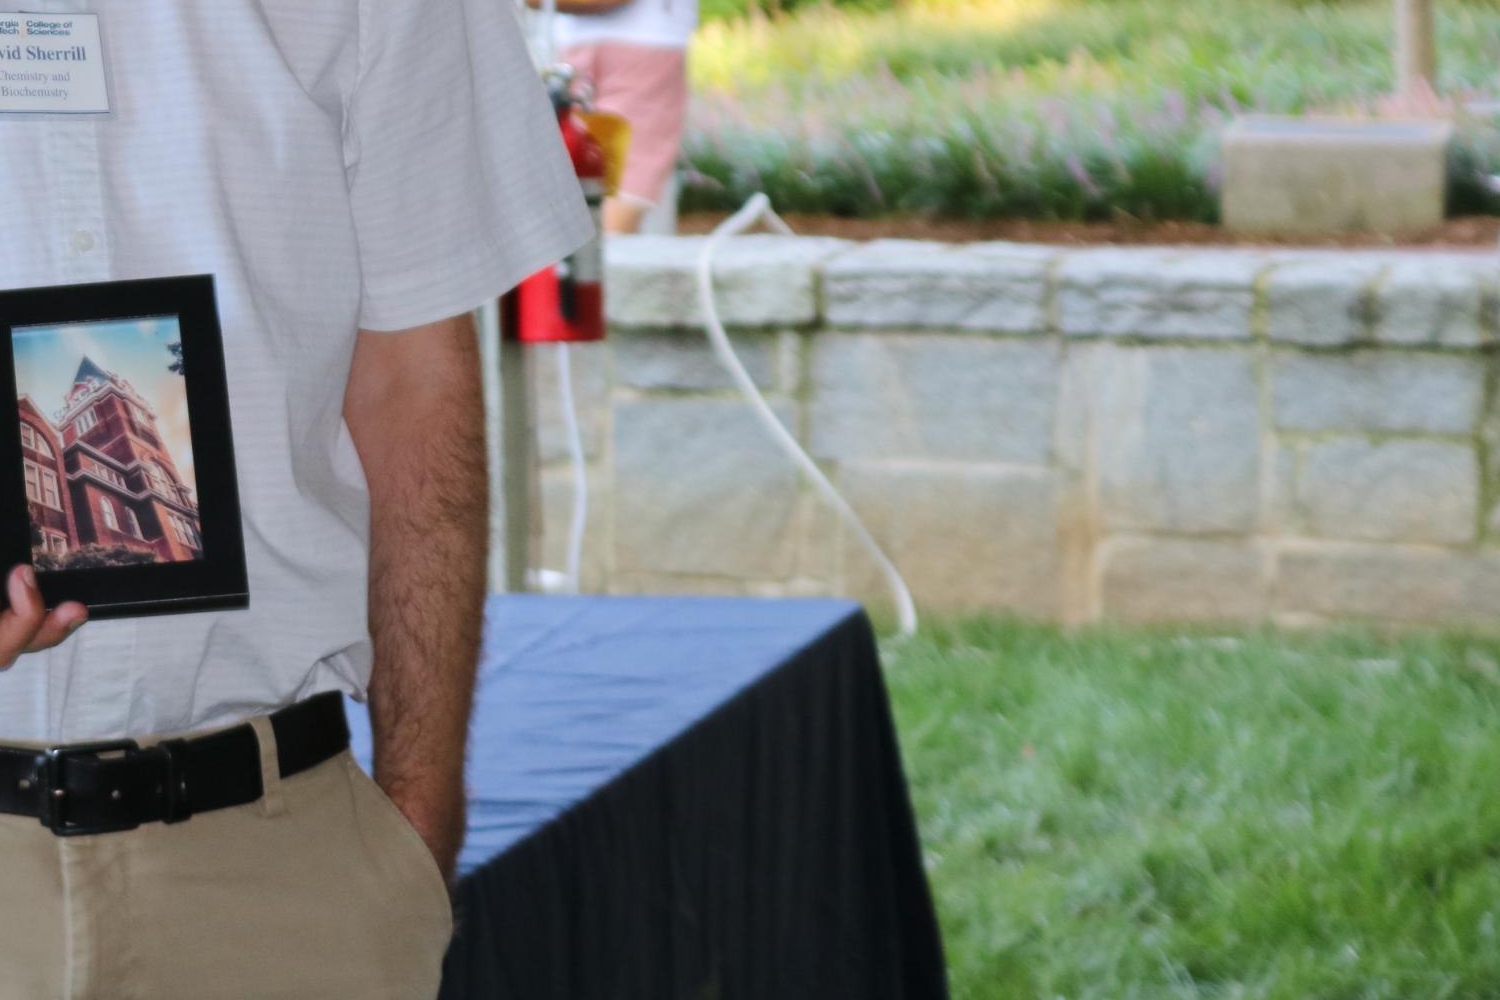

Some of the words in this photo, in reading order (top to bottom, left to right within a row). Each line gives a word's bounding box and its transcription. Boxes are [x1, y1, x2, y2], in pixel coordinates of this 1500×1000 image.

[26, 20, 61, 29] College
[62, 20, 72, 28] of
[26, 28, 71, 36] Sciences
[26, 45, 86, 61] Sherrill
[51, 71, 70, 82] and
[1, 86, 68, 100] Biochemistry
